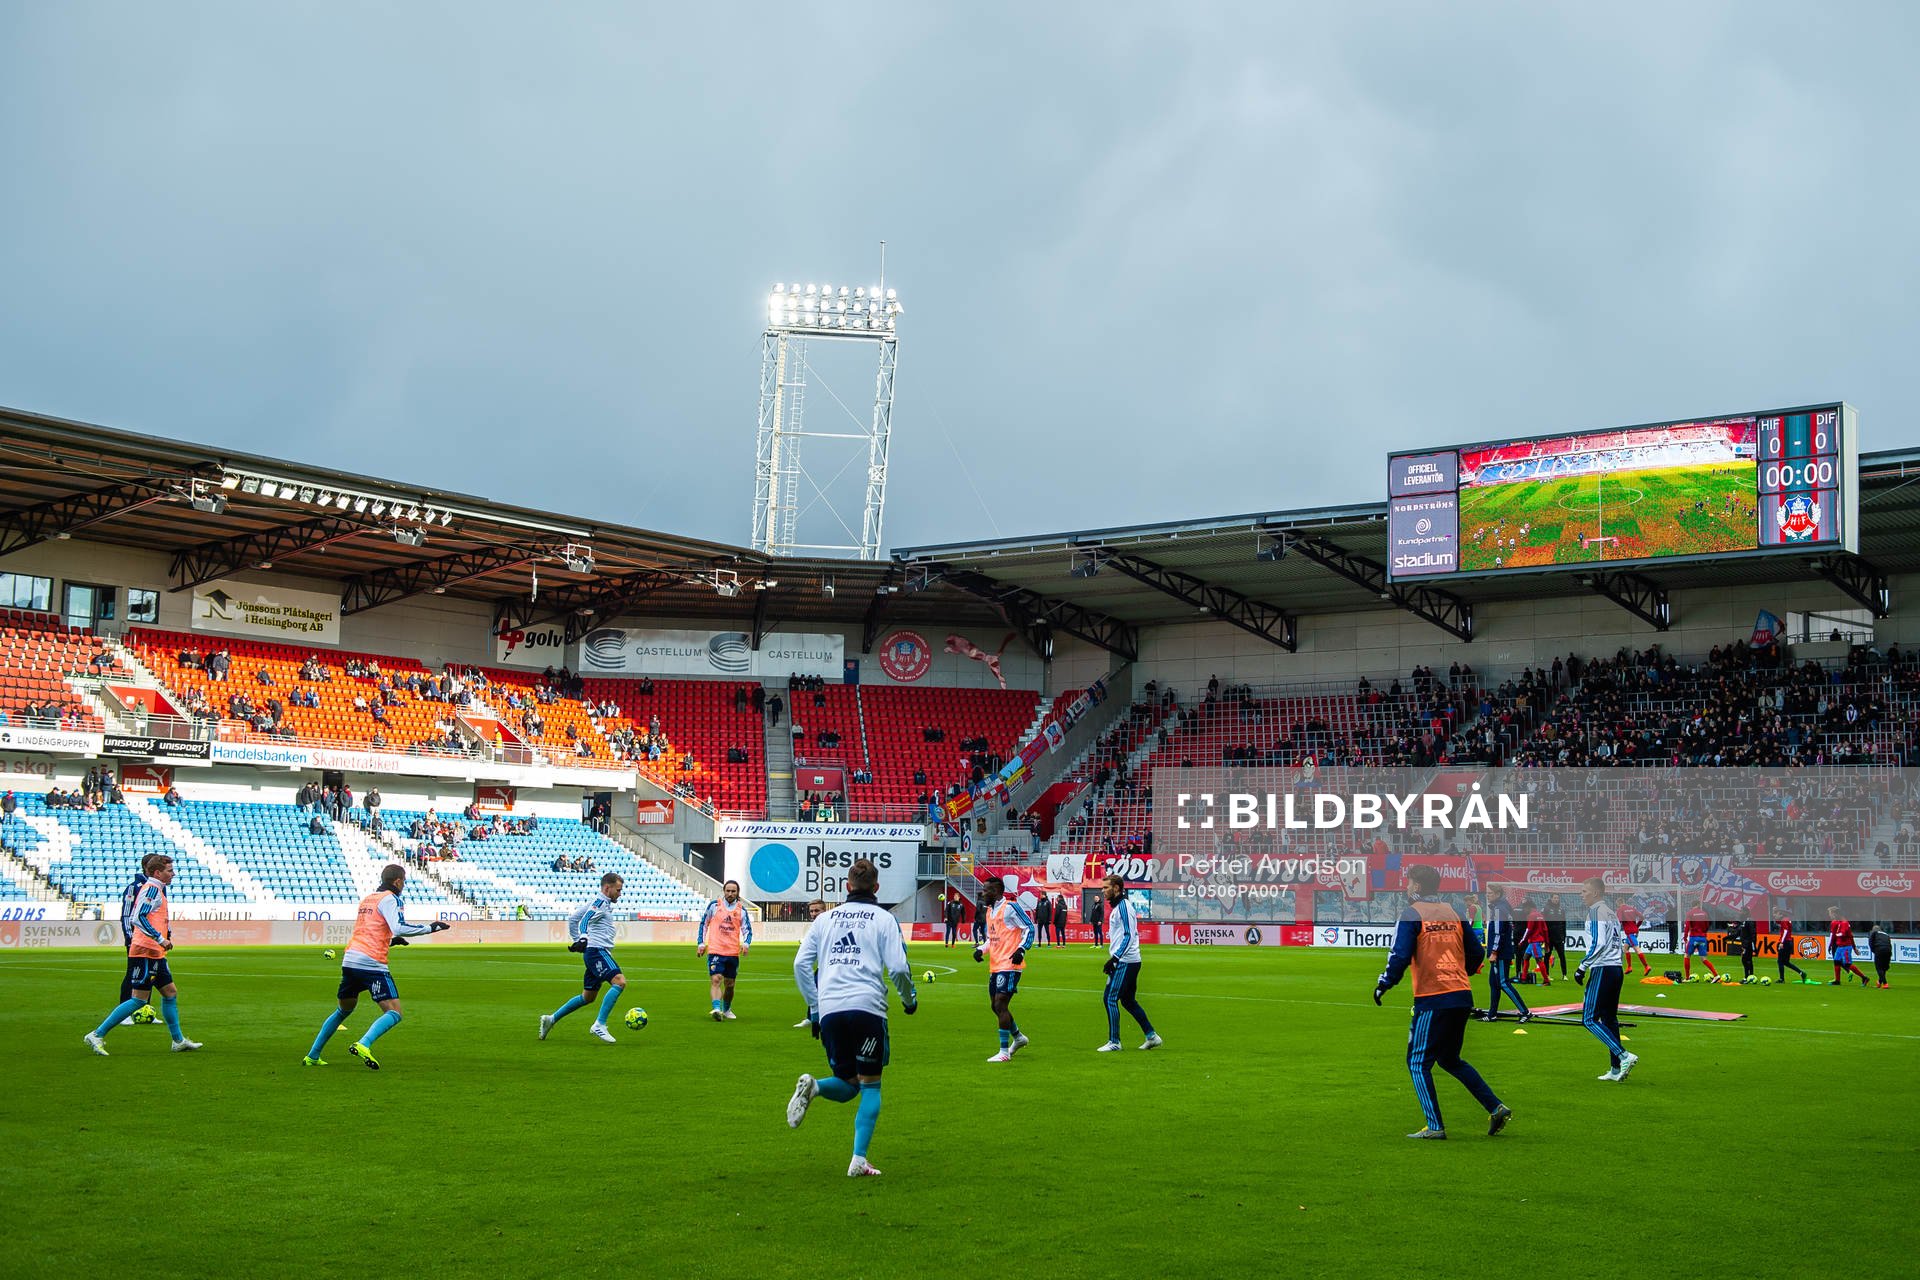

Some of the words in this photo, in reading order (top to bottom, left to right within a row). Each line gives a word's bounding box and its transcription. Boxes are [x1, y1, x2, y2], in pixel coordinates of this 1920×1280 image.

[1761, 419, 1780, 431] HIF
[1816, 413, 1836, 425] DIF
[1769, 437, 1781, 454] 0
[1815, 432, 1827, 449] 0
[1408, 463, 1438, 475] OFFICIELL
[1766, 462, 1832, 487] 00:00
[1404, 473, 1444, 486] LEVERANTÖR
[1394, 552, 1453, 568] stadium
[235, 601, 281, 614] Jönssons
[283, 606, 332, 622] Plåtslageri
[251, 615, 308, 632] Helsingborg
[309, 622, 324, 632] AB
[525, 629, 563, 648] golv
[635, 647, 702, 658] CASTELLUM
[768, 650, 833, 660] CASTELLUM
[213, 746, 307, 763] Handelsbanken
[13, 756, 57, 776] skor
[725, 825, 787, 834] KLIPPANS
[790, 826, 822, 835] BUSS
[826, 827, 887, 836] KLIPPANS
[890, 828, 922, 837] BUSS
[806, 846, 892, 868] Resurs
[1527, 870, 1574, 883] Carlsberg
[1768, 872, 1822, 890] Carlsberg
[1857, 873, 1914, 891] Carlsberg
[830, 910, 875, 920] Prioritet
[24, 926, 81, 937] SVENSKA
[327, 925, 352, 936] SVEN
[1194, 929, 1235, 938] SVENSKA
[831, 944, 861, 954] adidas
[829, 957, 860, 966] stadium
